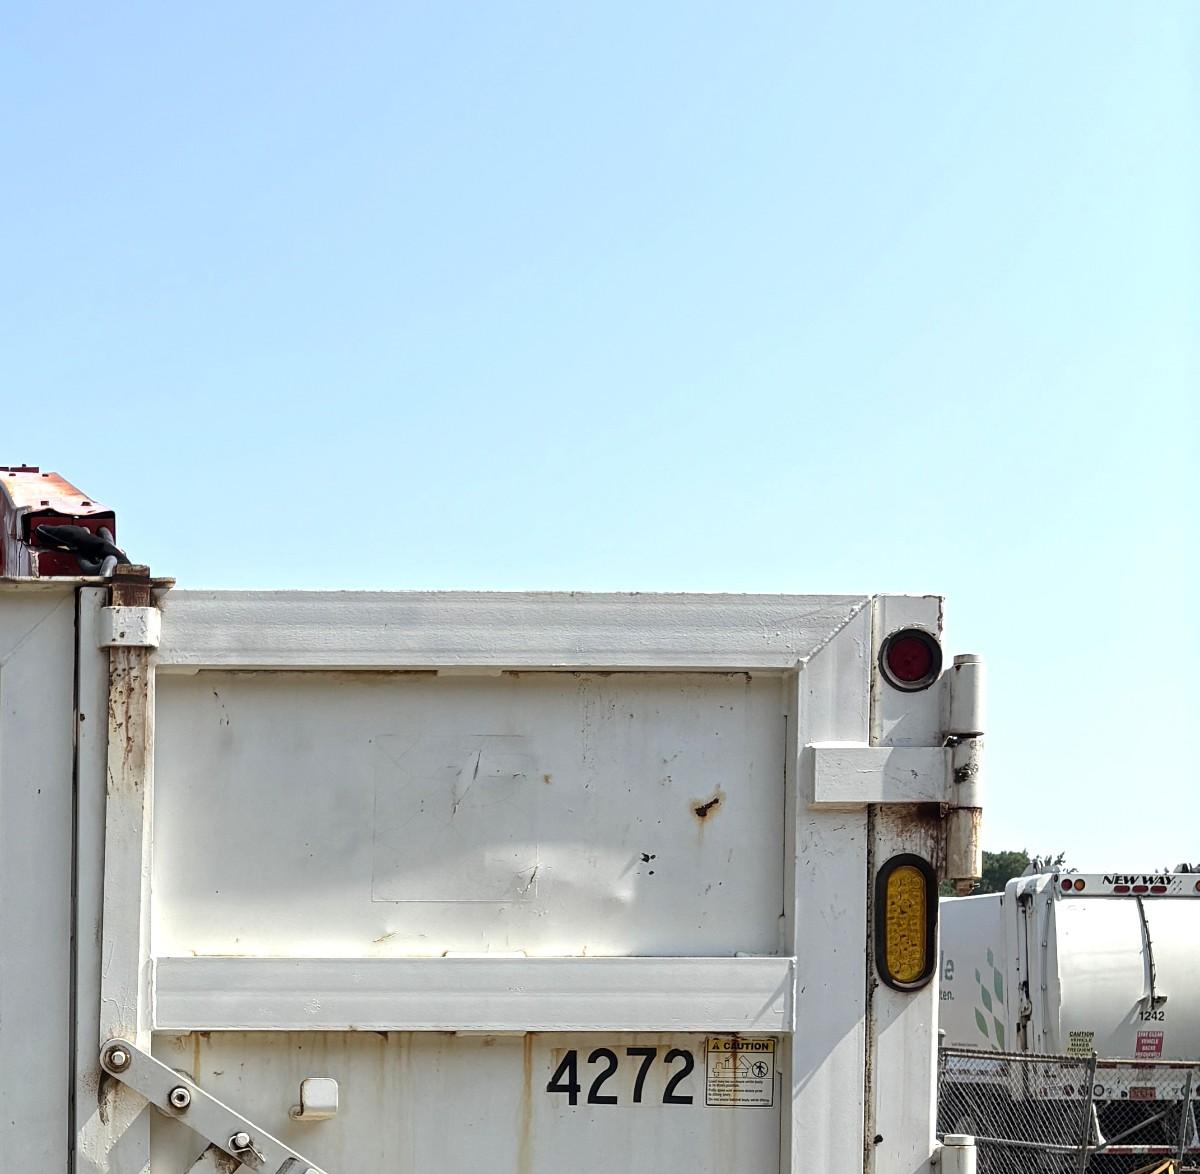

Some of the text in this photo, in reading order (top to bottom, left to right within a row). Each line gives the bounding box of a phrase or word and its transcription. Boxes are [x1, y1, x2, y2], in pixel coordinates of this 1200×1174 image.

[1102, 875, 1177, 885] NEW WAY
[1139, 1010, 1166, 1021] 1242
[723, 1042, 769, 1051] CAUTION
[546, 1047, 695, 1106] 4272
